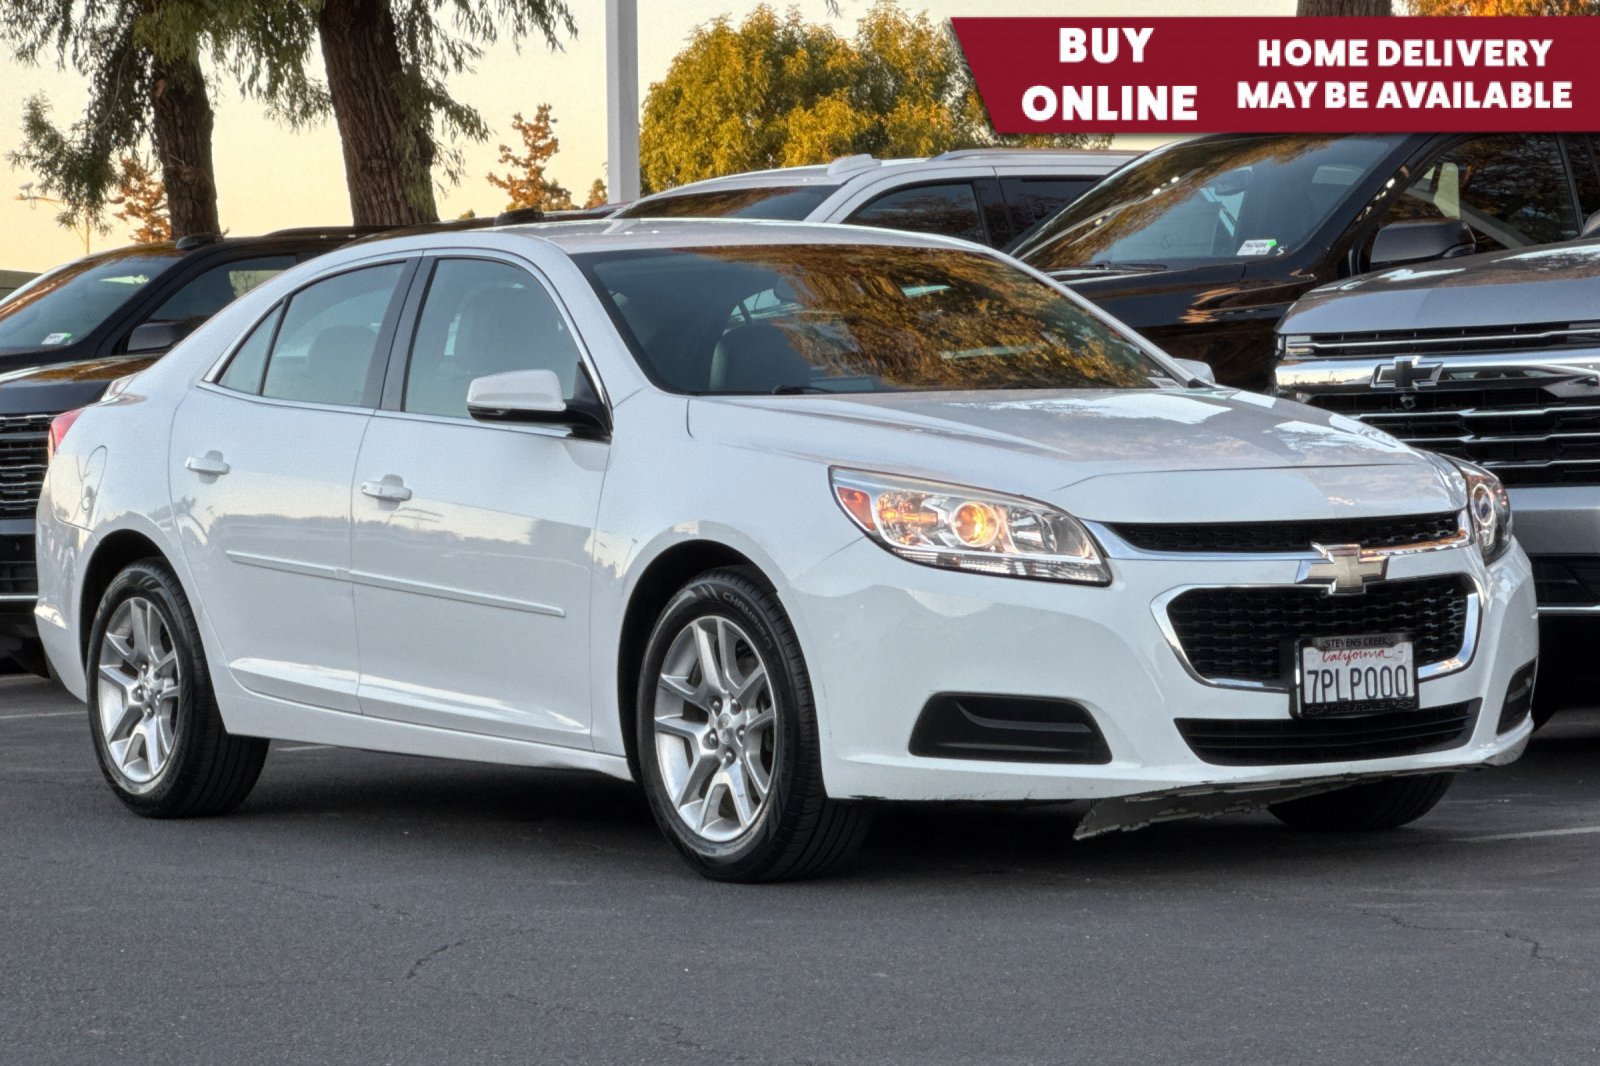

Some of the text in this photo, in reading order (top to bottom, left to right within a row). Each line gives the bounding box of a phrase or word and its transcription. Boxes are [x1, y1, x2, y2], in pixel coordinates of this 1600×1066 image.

[723, 592, 772, 650] CHAMPIRO
[1322, 646, 1392, 666] California
[1324, 637, 1388, 648] STEVENS CREEK
[1307, 665, 1408, 703] 7PLP000
